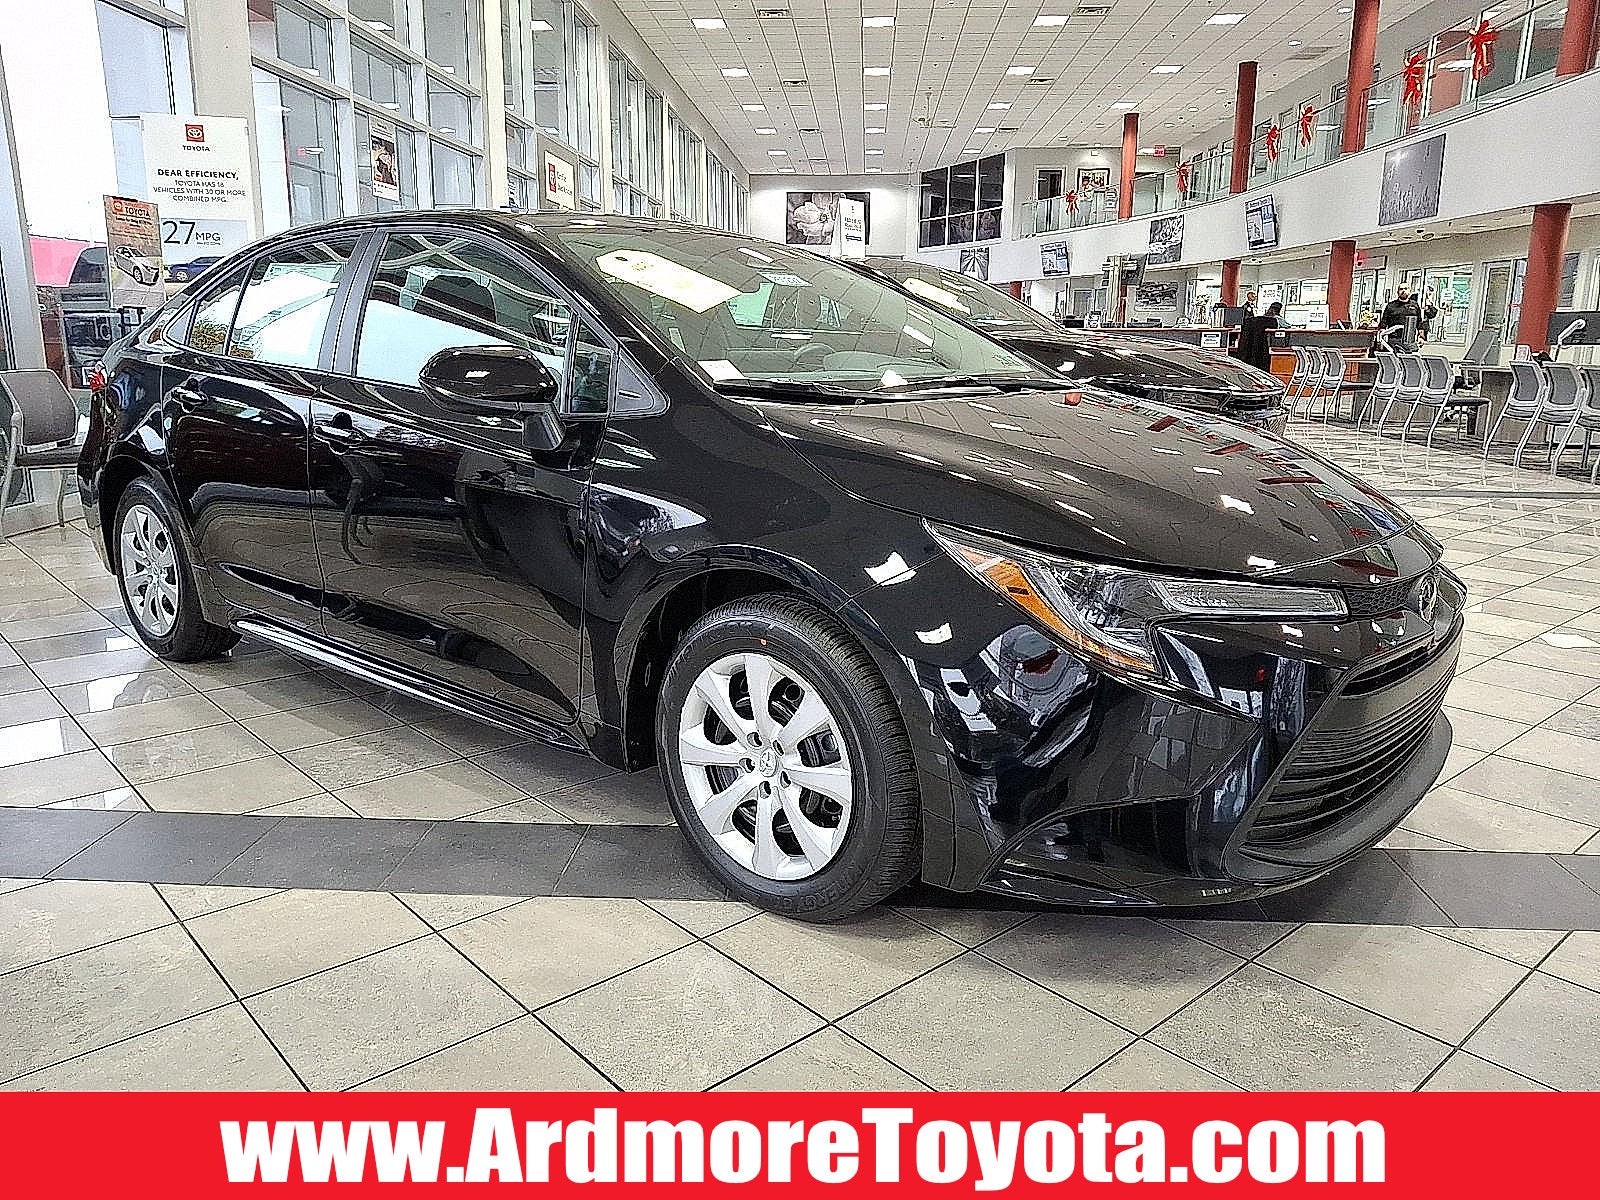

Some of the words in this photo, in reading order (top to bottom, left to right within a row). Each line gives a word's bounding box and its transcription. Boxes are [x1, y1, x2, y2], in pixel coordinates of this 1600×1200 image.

[157, 168, 183, 177] DEAR
[184, 170, 239, 181] EFFICIENCY,
[174, 179, 201, 187] TOYOTA
[153, 186, 185, 194] VEHICLES
[185, 187, 204, 195] WITH
[124, 206, 150, 217] TOYOTA
[163, 221, 195, 244] 27
[195, 231, 221, 242] MPG
